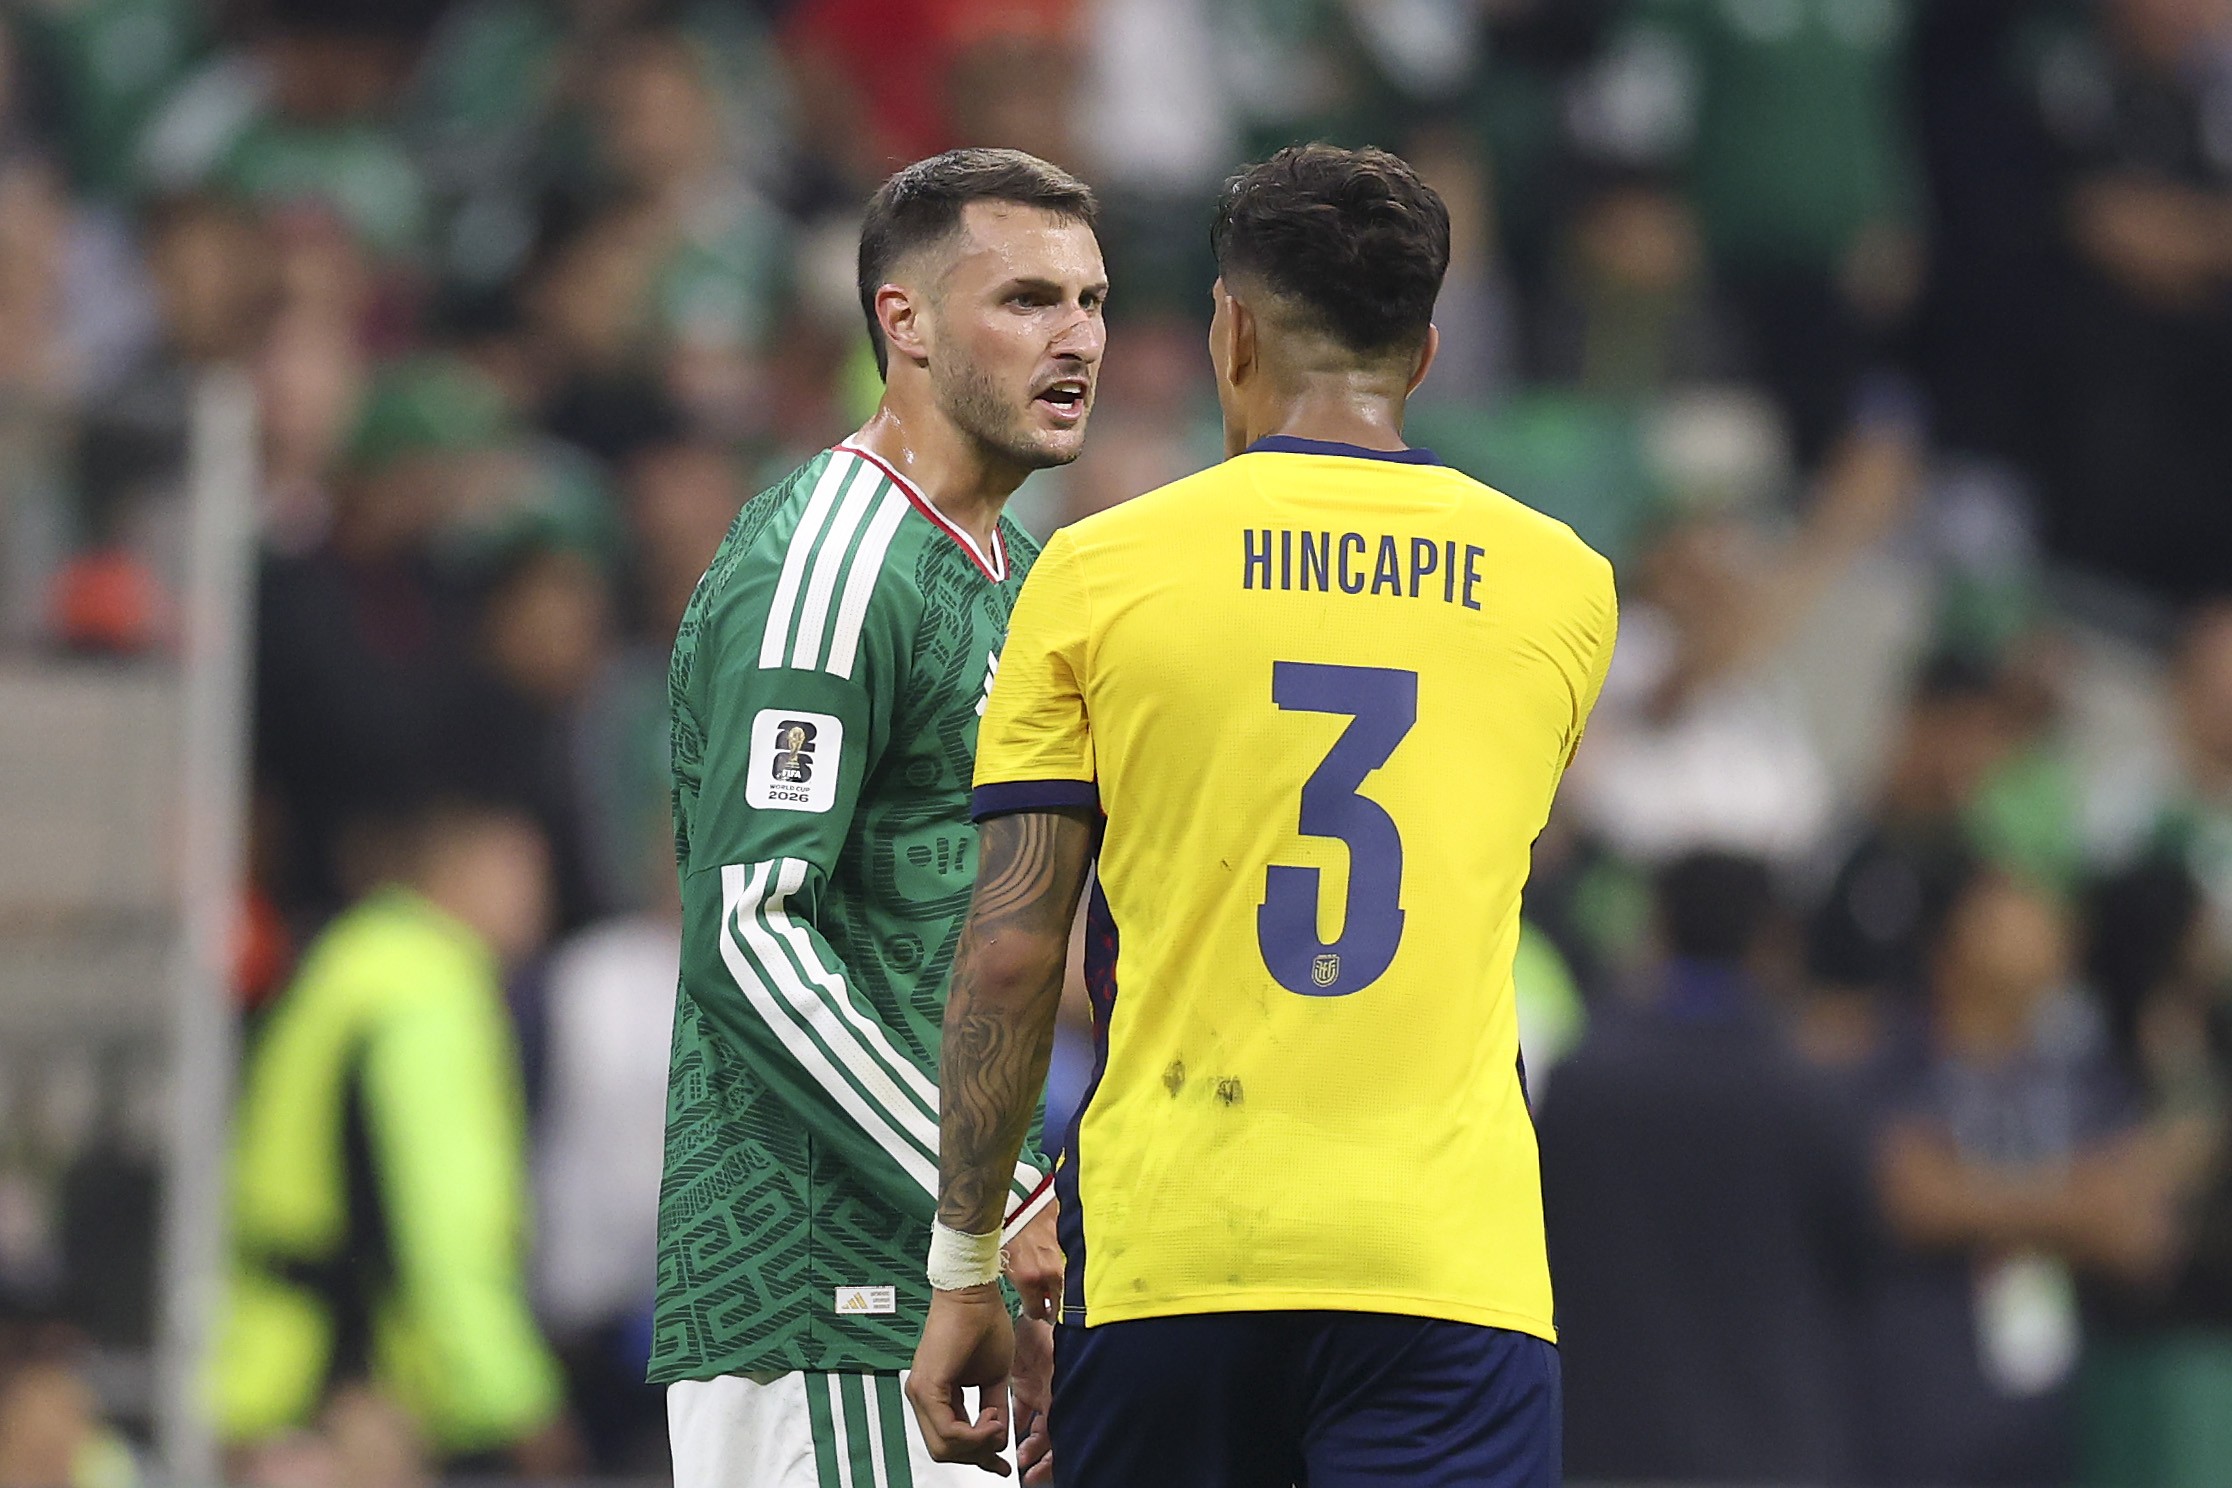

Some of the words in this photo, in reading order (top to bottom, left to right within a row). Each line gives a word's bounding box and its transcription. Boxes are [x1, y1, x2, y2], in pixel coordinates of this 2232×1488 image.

[1243, 529, 1486, 611] HINCAPIE
[768, 791, 809, 802] 2026
[782, 769, 801, 778] FIFA
[1257, 660, 1418, 997] 3
